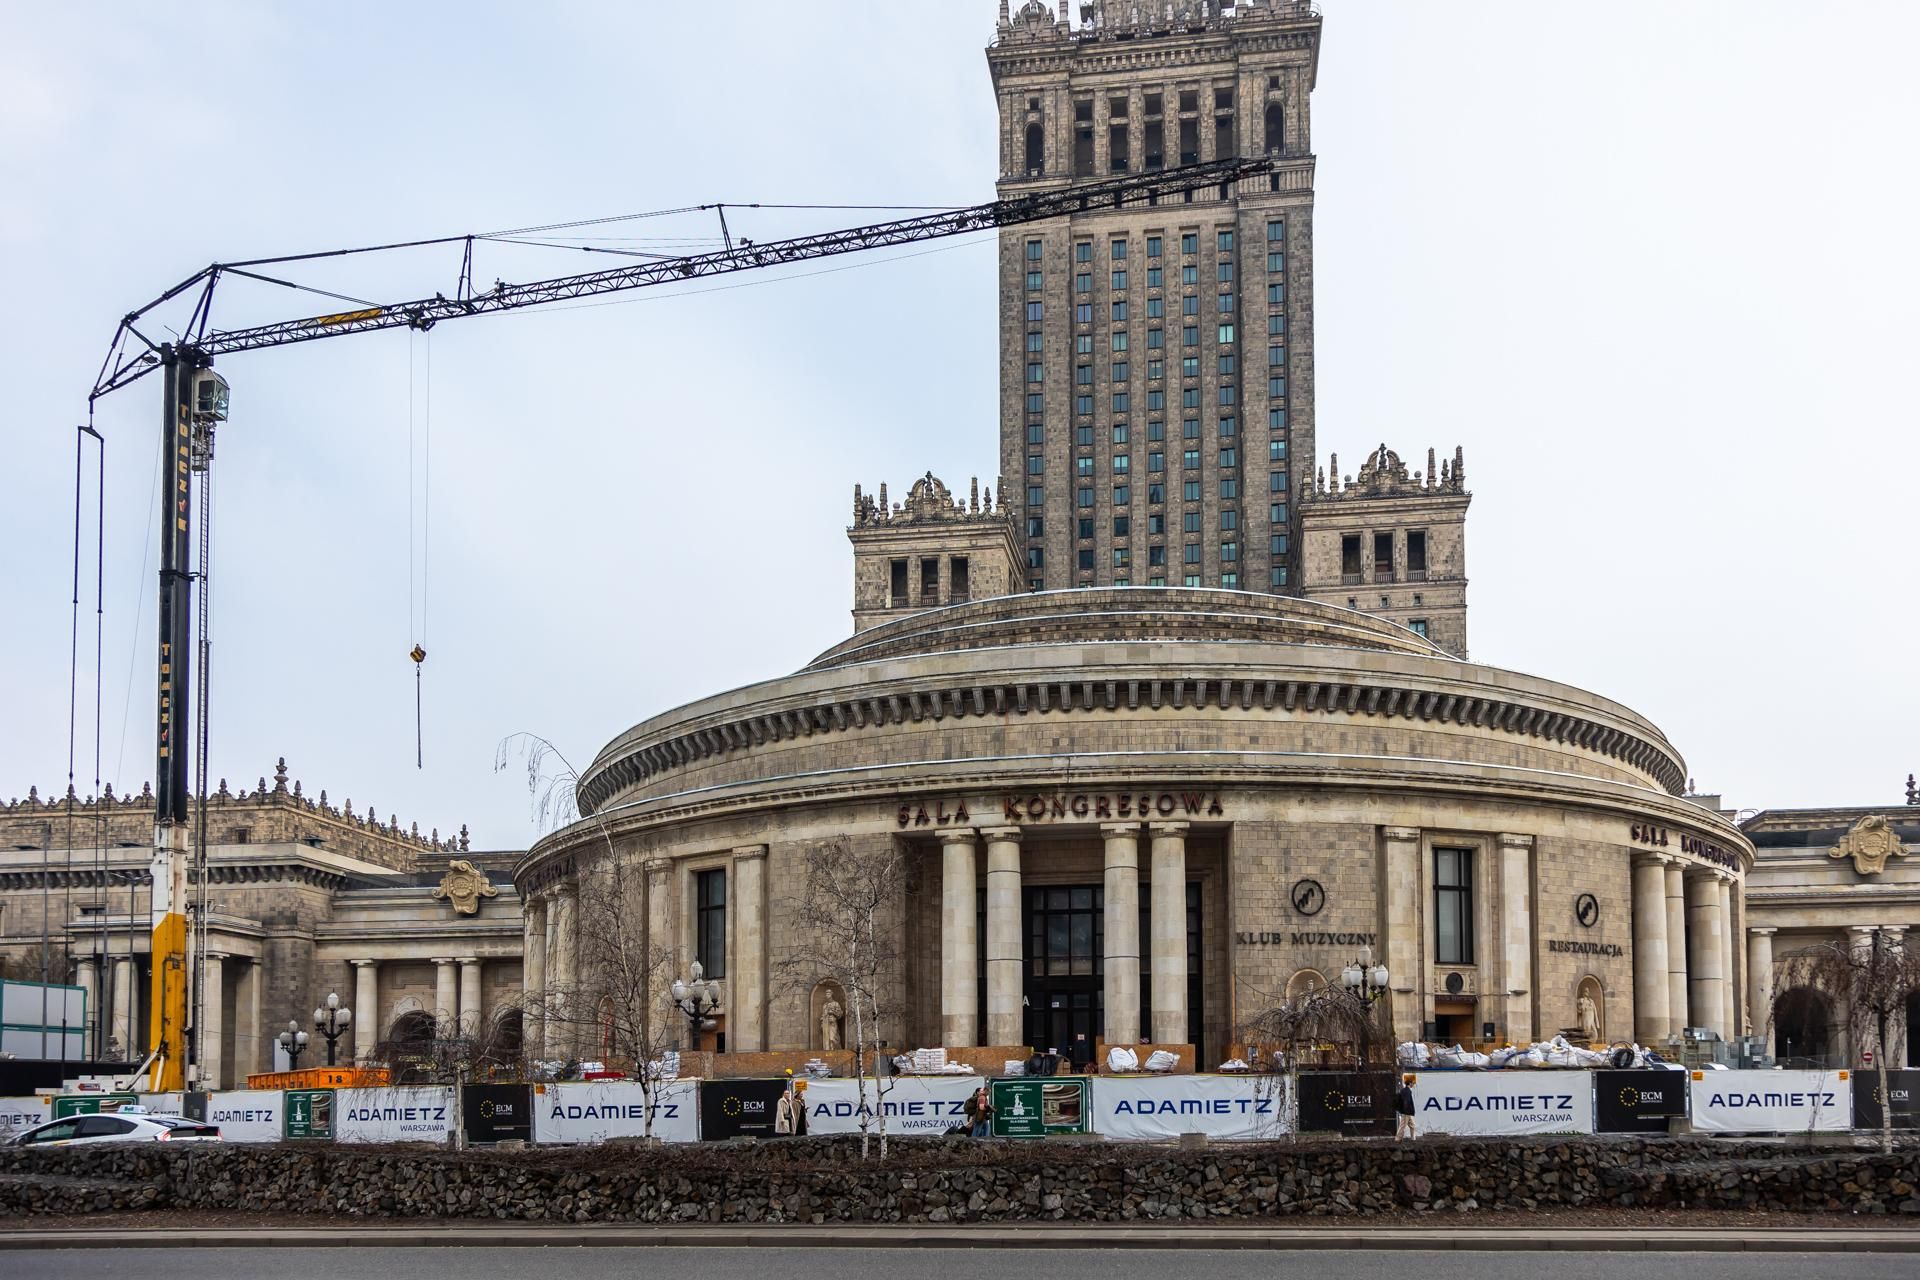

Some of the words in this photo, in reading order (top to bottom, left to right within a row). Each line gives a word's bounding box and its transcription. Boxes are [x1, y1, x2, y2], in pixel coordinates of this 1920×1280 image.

[898, 800, 970, 828] SALA
[1004, 791, 1224, 819] KONGRESOWA
[1631, 823, 1668, 847] SALA
[1236, 932, 1282, 945] KLUB
[1291, 932, 1377, 946] MUZYCZNY
[1549, 940, 1623, 958] RESTAURACJA
[328, 1075, 343, 1084] 18
[1347, 1095, 1371, 1104] ECM
[1641, 1091, 1662, 1100] ECM
[1709, 1093, 1835, 1108] ADAMIETZ
[1891, 1090, 1909, 1099] ECM
[496, 1104, 512, 1112] ECM
[743, 1101, 765, 1110] ECM
[813, 1101, 965, 1117] ADAMIETZ
[1114, 1099, 1272, 1115] ADAMIETZ
[1423, 1095, 1573, 1111] ADAMIETZ
[212, 1110, 272, 1121] ADAMIETZ
[347, 1107, 446, 1121] ADAMIETZ
[551, 1105, 679, 1119] ADAMIETZ
[1512, 1113, 1573, 1123] WARSZAWA
[400, 1124, 445, 1132] WARSZAWA
[902, 1119, 964, 1129] WARSZAWA
